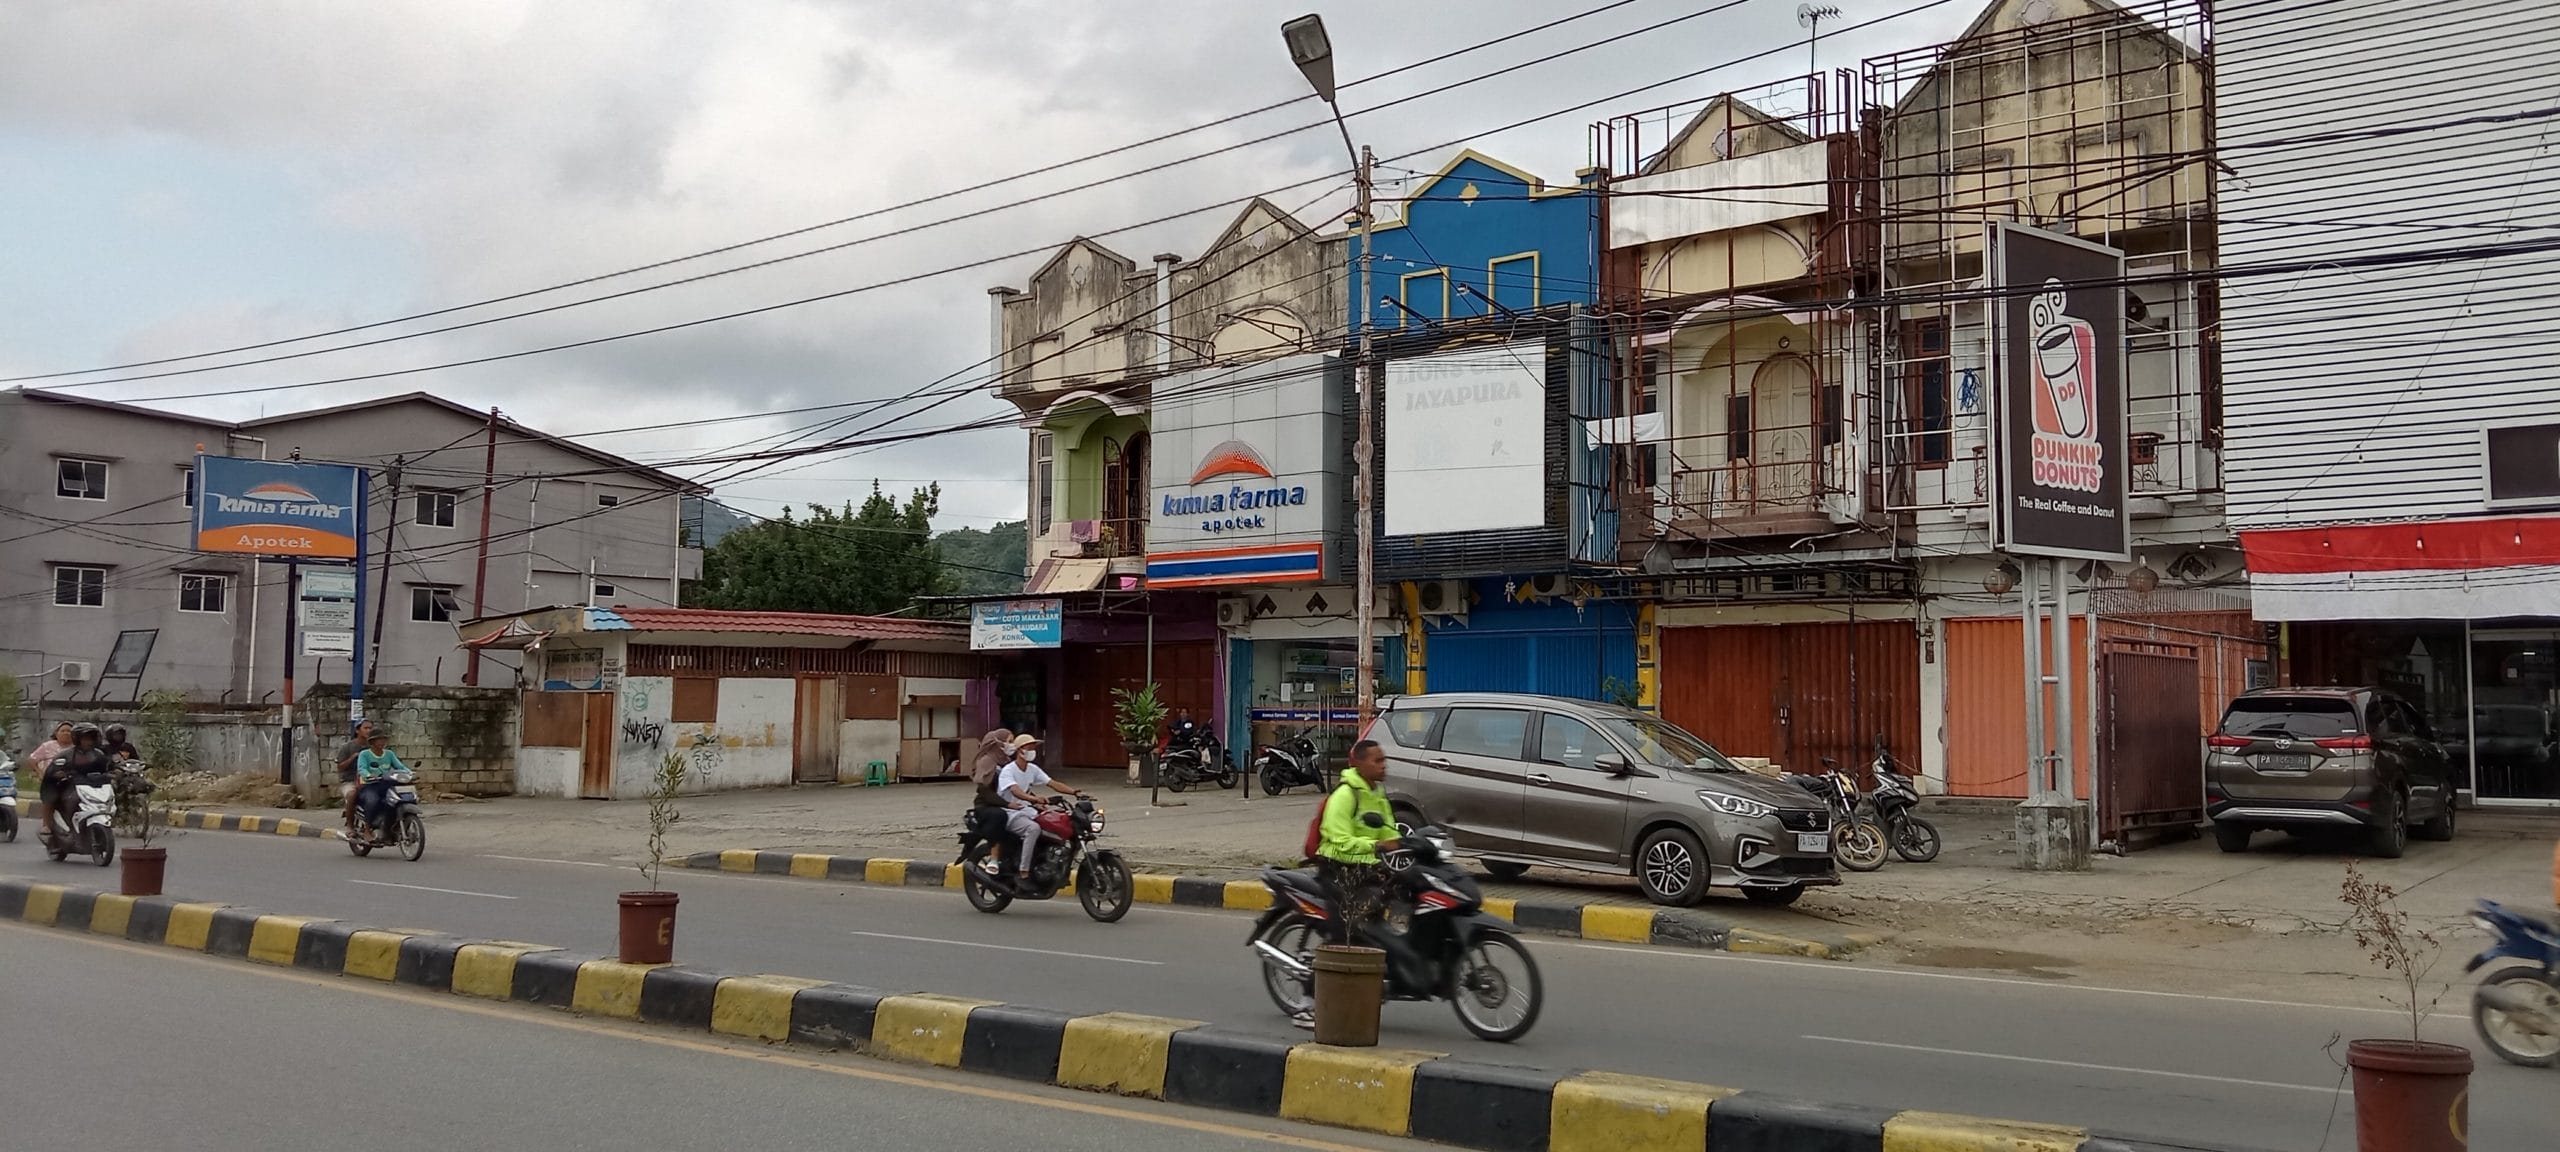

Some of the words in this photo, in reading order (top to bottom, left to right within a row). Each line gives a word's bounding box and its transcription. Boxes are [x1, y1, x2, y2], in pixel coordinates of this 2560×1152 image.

[1406, 380, 1521, 411] JAYAPURA
[2058, 381, 2076, 401] DD
[2034, 438, 2100, 466] DUNKIN'
[2034, 460, 2098, 488] DONUTS
[218, 497, 276, 513] kimia
[280, 501, 340, 518] farma
[1163, 493, 1226, 516] kimia
[1229, 486, 1306, 511] farma
[2018, 496, 2033, 509] The
[2034, 498, 2051, 510] Real
[2052, 500, 2076, 514] Coffee
[2077, 504, 2092, 515] and
[2093, 505, 2115, 518] Donut
[1202, 515, 1265, 533] apotek
[237, 534, 312, 549] Apotek
[1002, 615, 1020, 623] COTO
[1021, 613, 1060, 622] MAKASSAR
[2260, 755, 2271, 764] PA
